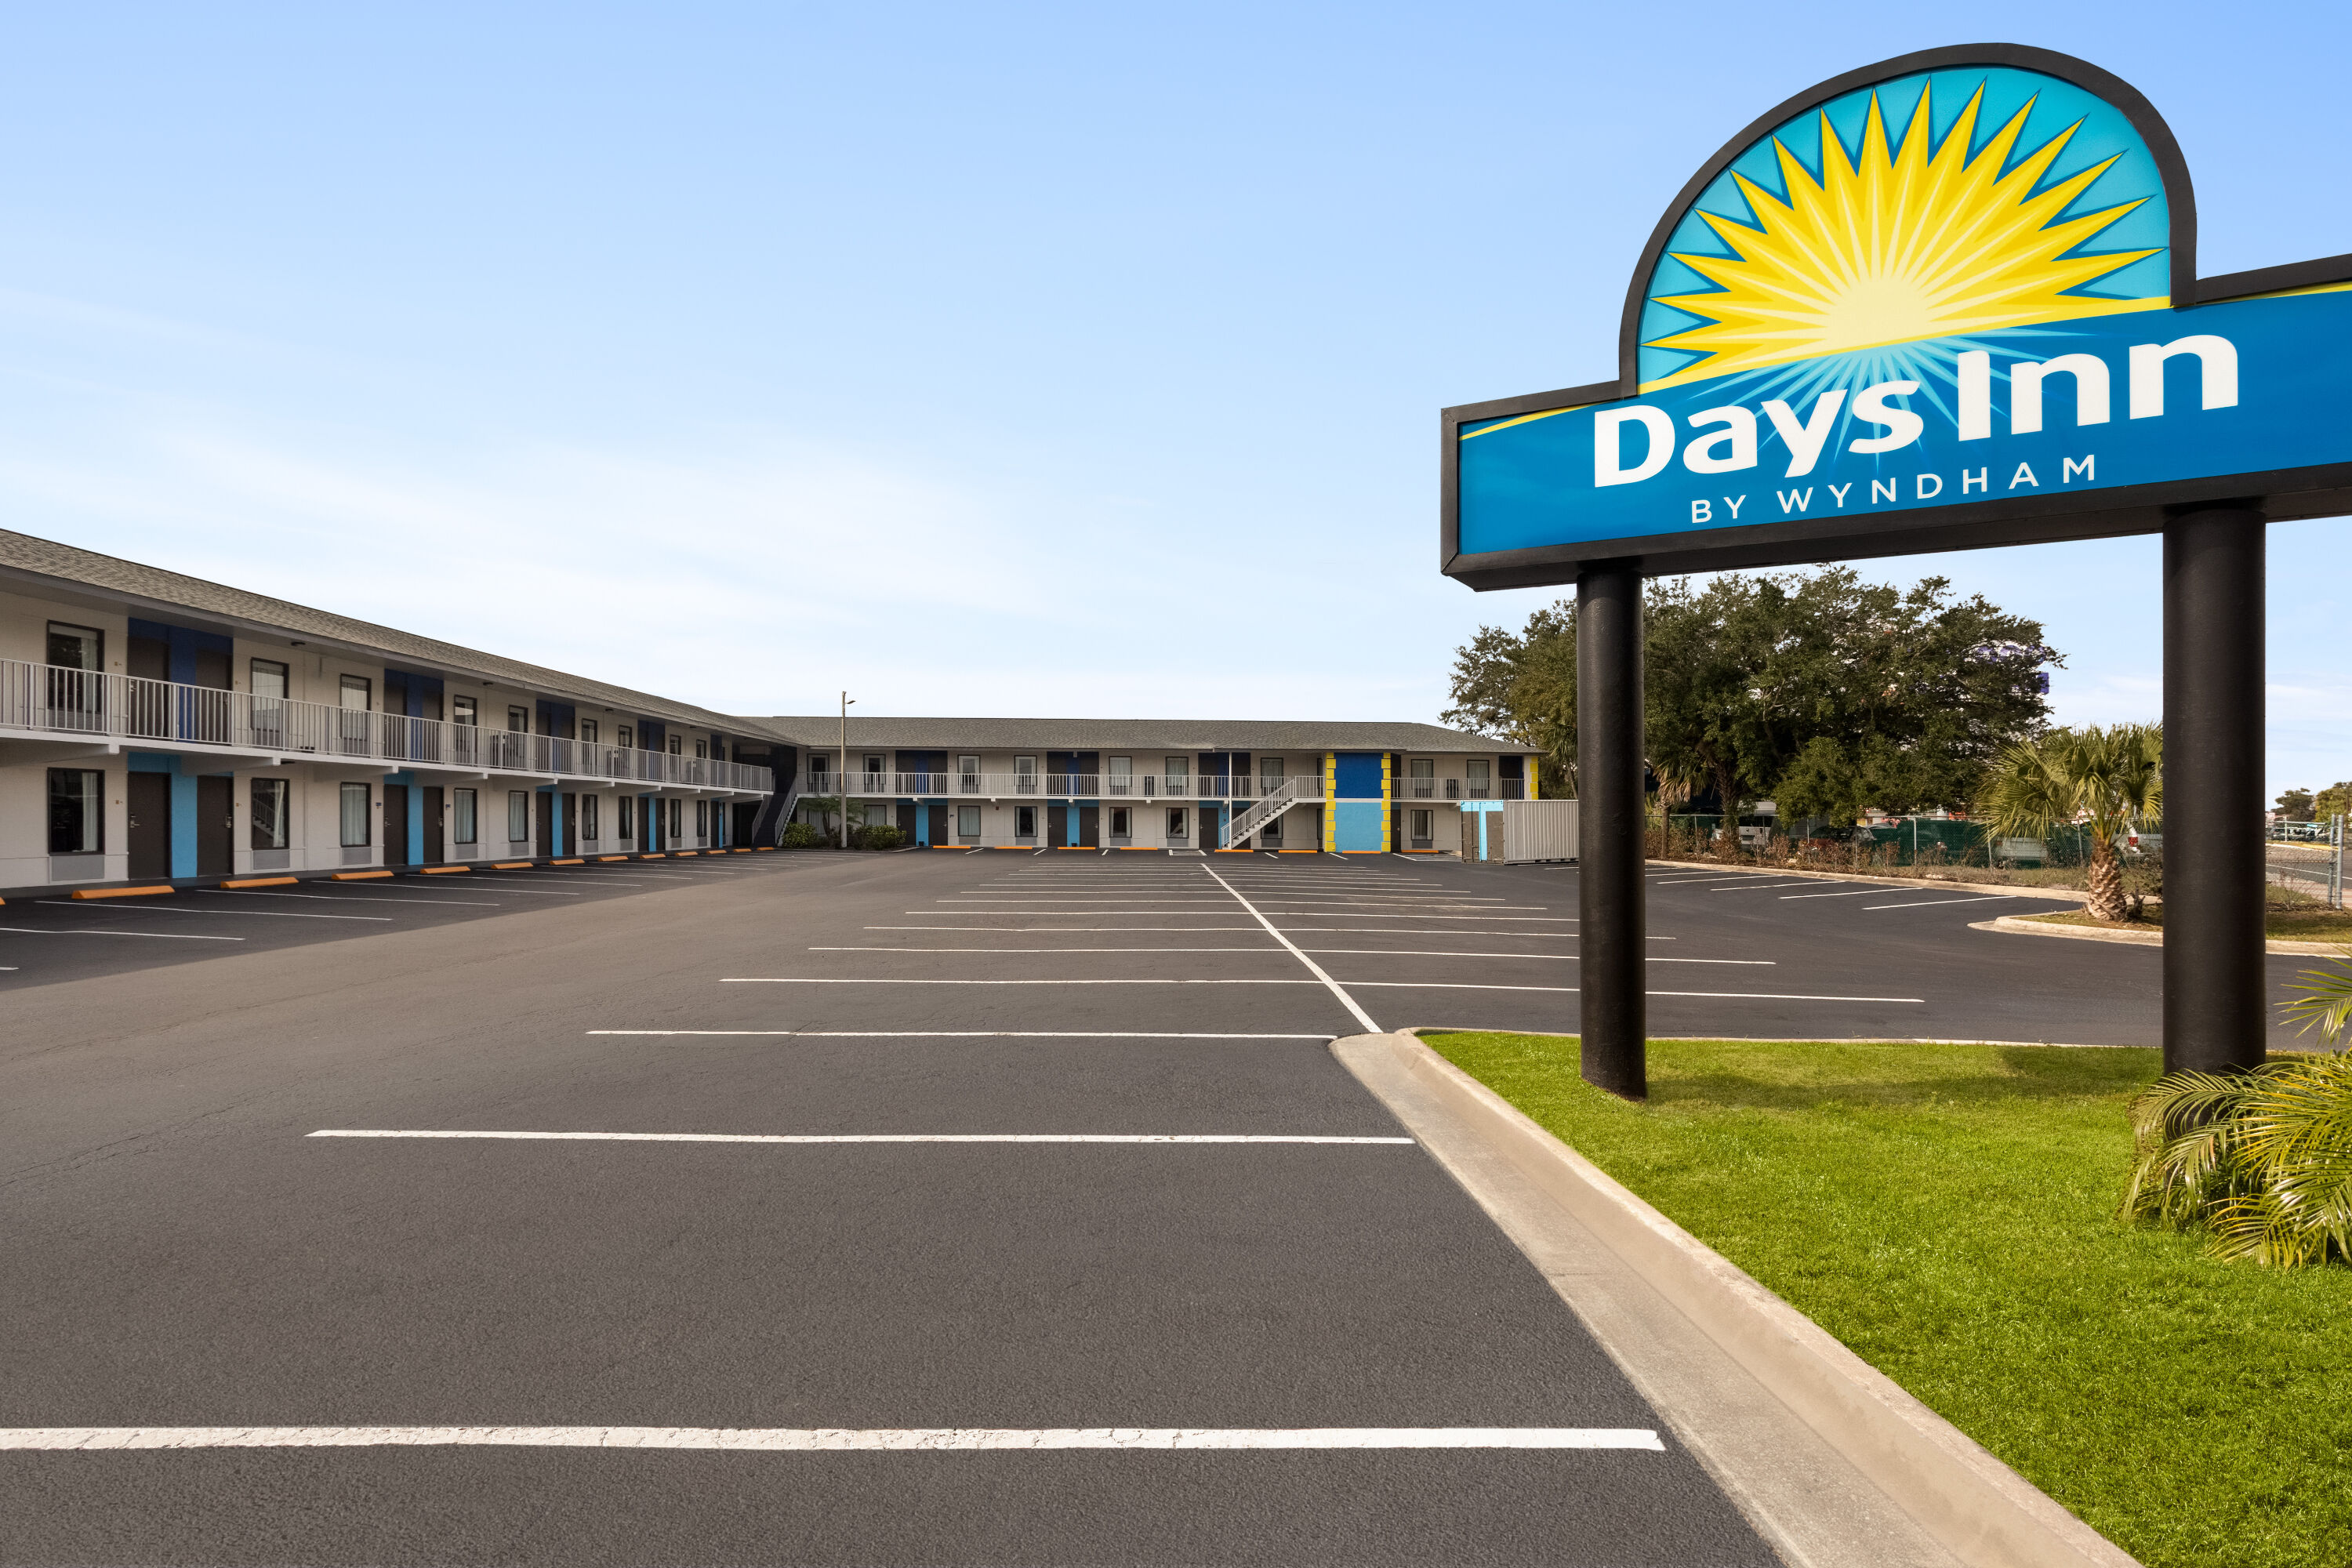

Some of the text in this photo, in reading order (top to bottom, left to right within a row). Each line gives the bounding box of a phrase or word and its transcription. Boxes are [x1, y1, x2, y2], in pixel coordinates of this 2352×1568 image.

[1594, 335, 2238, 488] Days Inn
[1691, 454, 2096, 524] BY WYNDHAM
